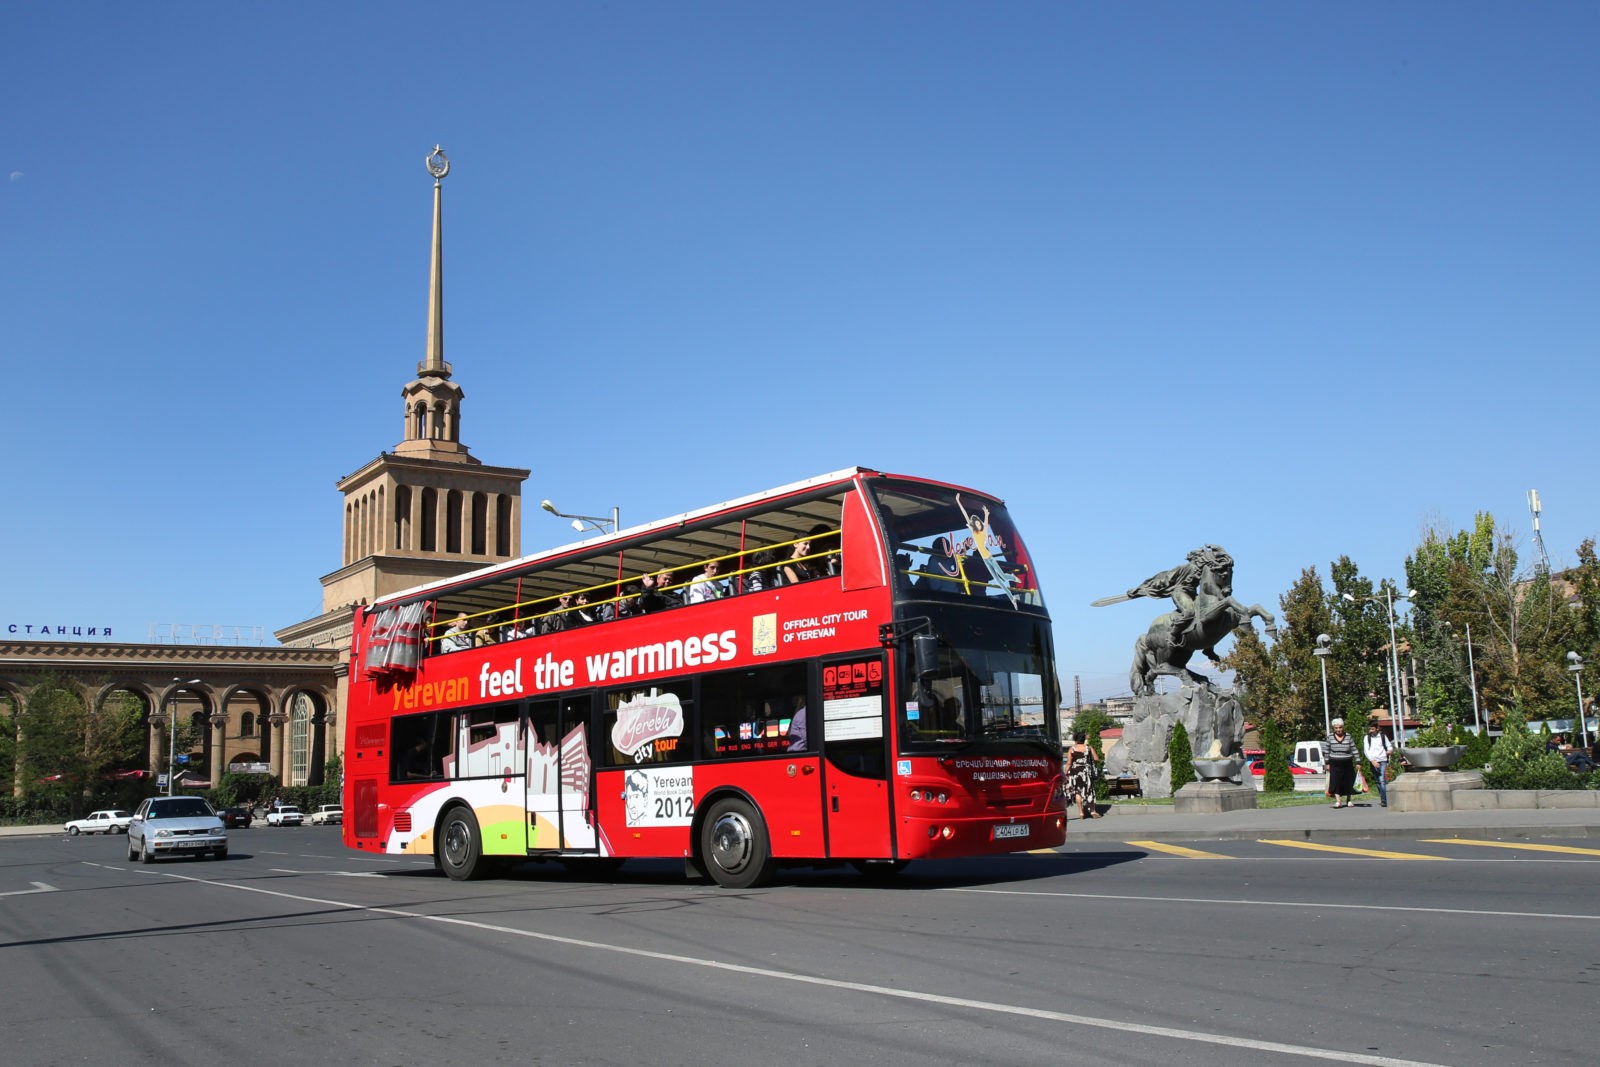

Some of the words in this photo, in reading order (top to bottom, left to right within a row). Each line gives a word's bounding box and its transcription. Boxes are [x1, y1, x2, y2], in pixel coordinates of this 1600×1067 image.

[8, 624, 112, 636] СТАНЦИЯ
[783, 617, 820, 631] OFFICIAL
[821, 613, 841, 625] CITY
[843, 609, 868, 622] TOUR
[783, 632, 795, 642] OF
[796, 627, 836, 641] YEREVAN
[391, 676, 469, 711] Yerevan
[479, 657, 523, 698] feel
[534, 652, 574, 690] the
[586, 629, 737, 682] warmness
[634, 742, 653, 764] city
[654, 738, 678, 752] tour
[653, 776, 693, 788] Yerevan
[655, 796, 694, 819] 2012
